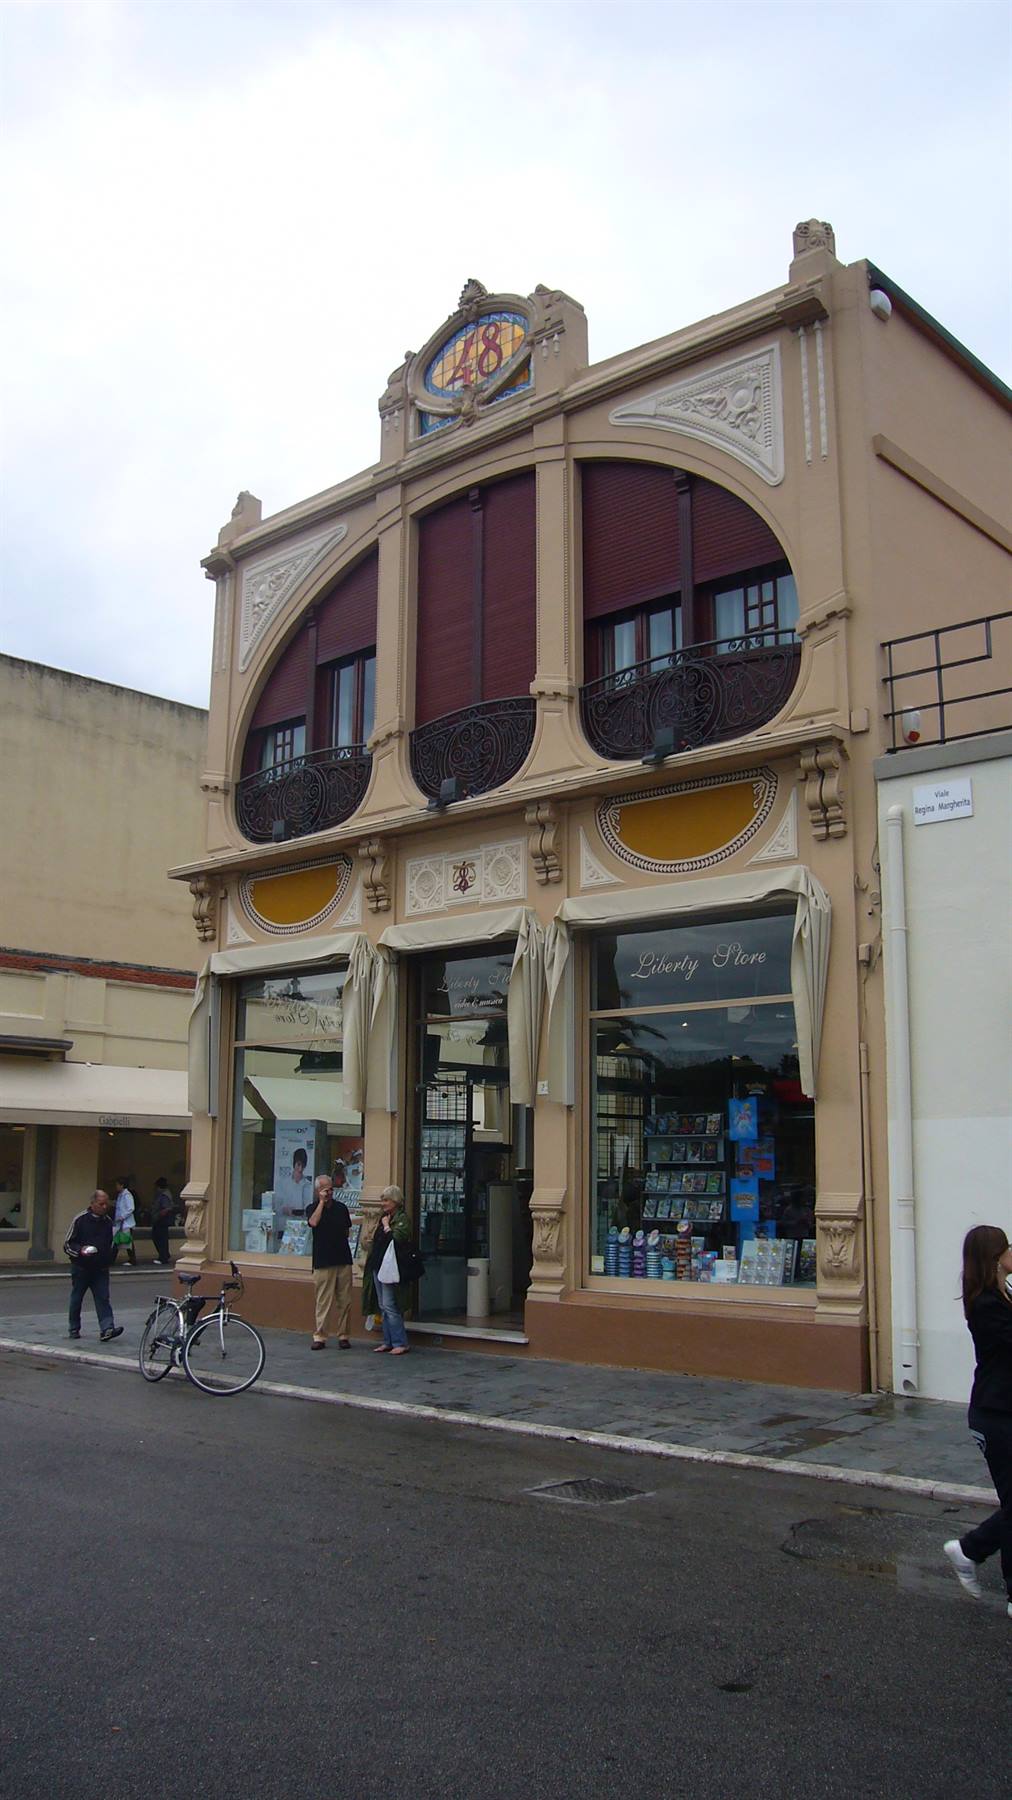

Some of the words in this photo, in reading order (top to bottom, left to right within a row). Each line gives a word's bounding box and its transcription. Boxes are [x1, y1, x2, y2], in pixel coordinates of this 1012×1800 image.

[446, 322, 503, 386] 48
[914, 804, 935, 816] Regina
[938, 798, 971, 811] Margherita
[934, 789, 950, 798] Viale
[631, 951, 699, 980] Liberty
[712, 942, 767, 968] Store
